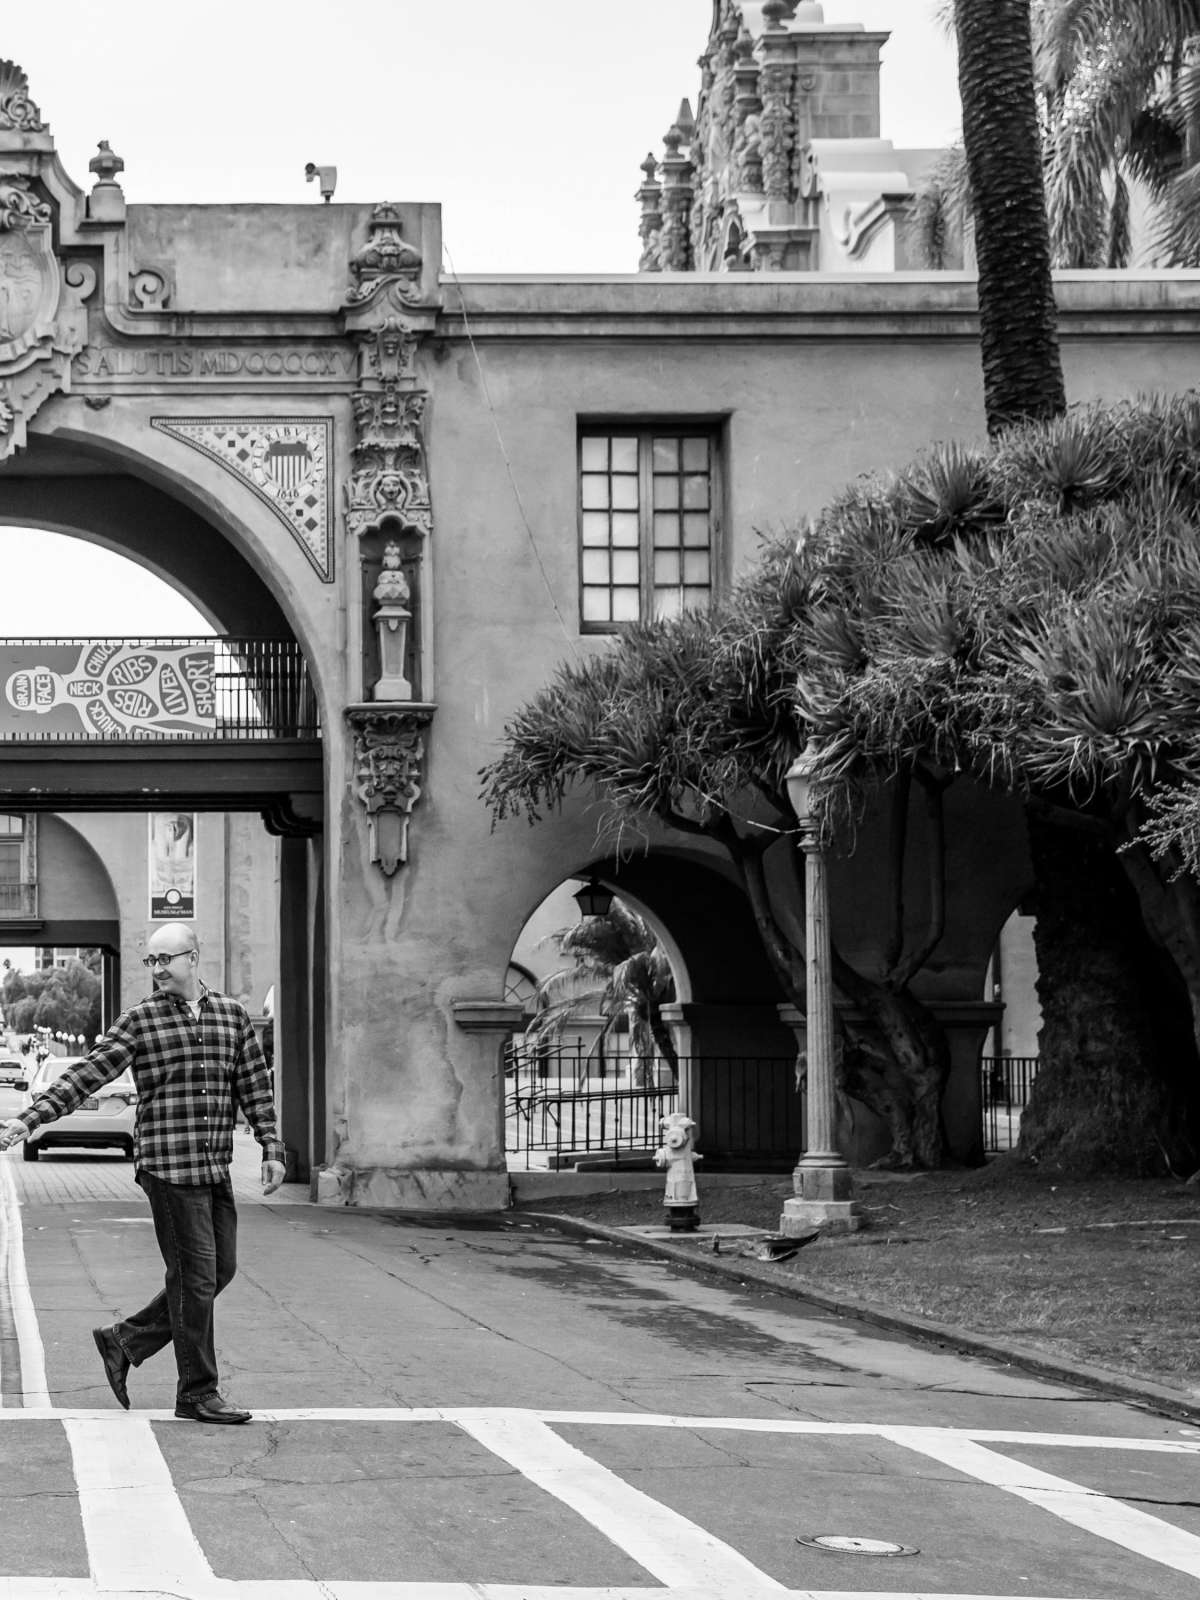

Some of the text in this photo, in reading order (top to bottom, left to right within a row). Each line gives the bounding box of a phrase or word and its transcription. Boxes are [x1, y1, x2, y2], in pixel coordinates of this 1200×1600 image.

[75, 351, 193, 376] SALUTIS
[87, 645, 116, 674] CHUC
[111, 656, 153, 685] RIBS
[16, 675, 29, 706] BRAIN
[36, 675, 52, 704] FACE
[69, 681, 101, 696] NECK
[161, 667, 187, 713] LIVER
[185, 657, 212, 715] SHORT
[113, 690, 153, 718] RIBS
